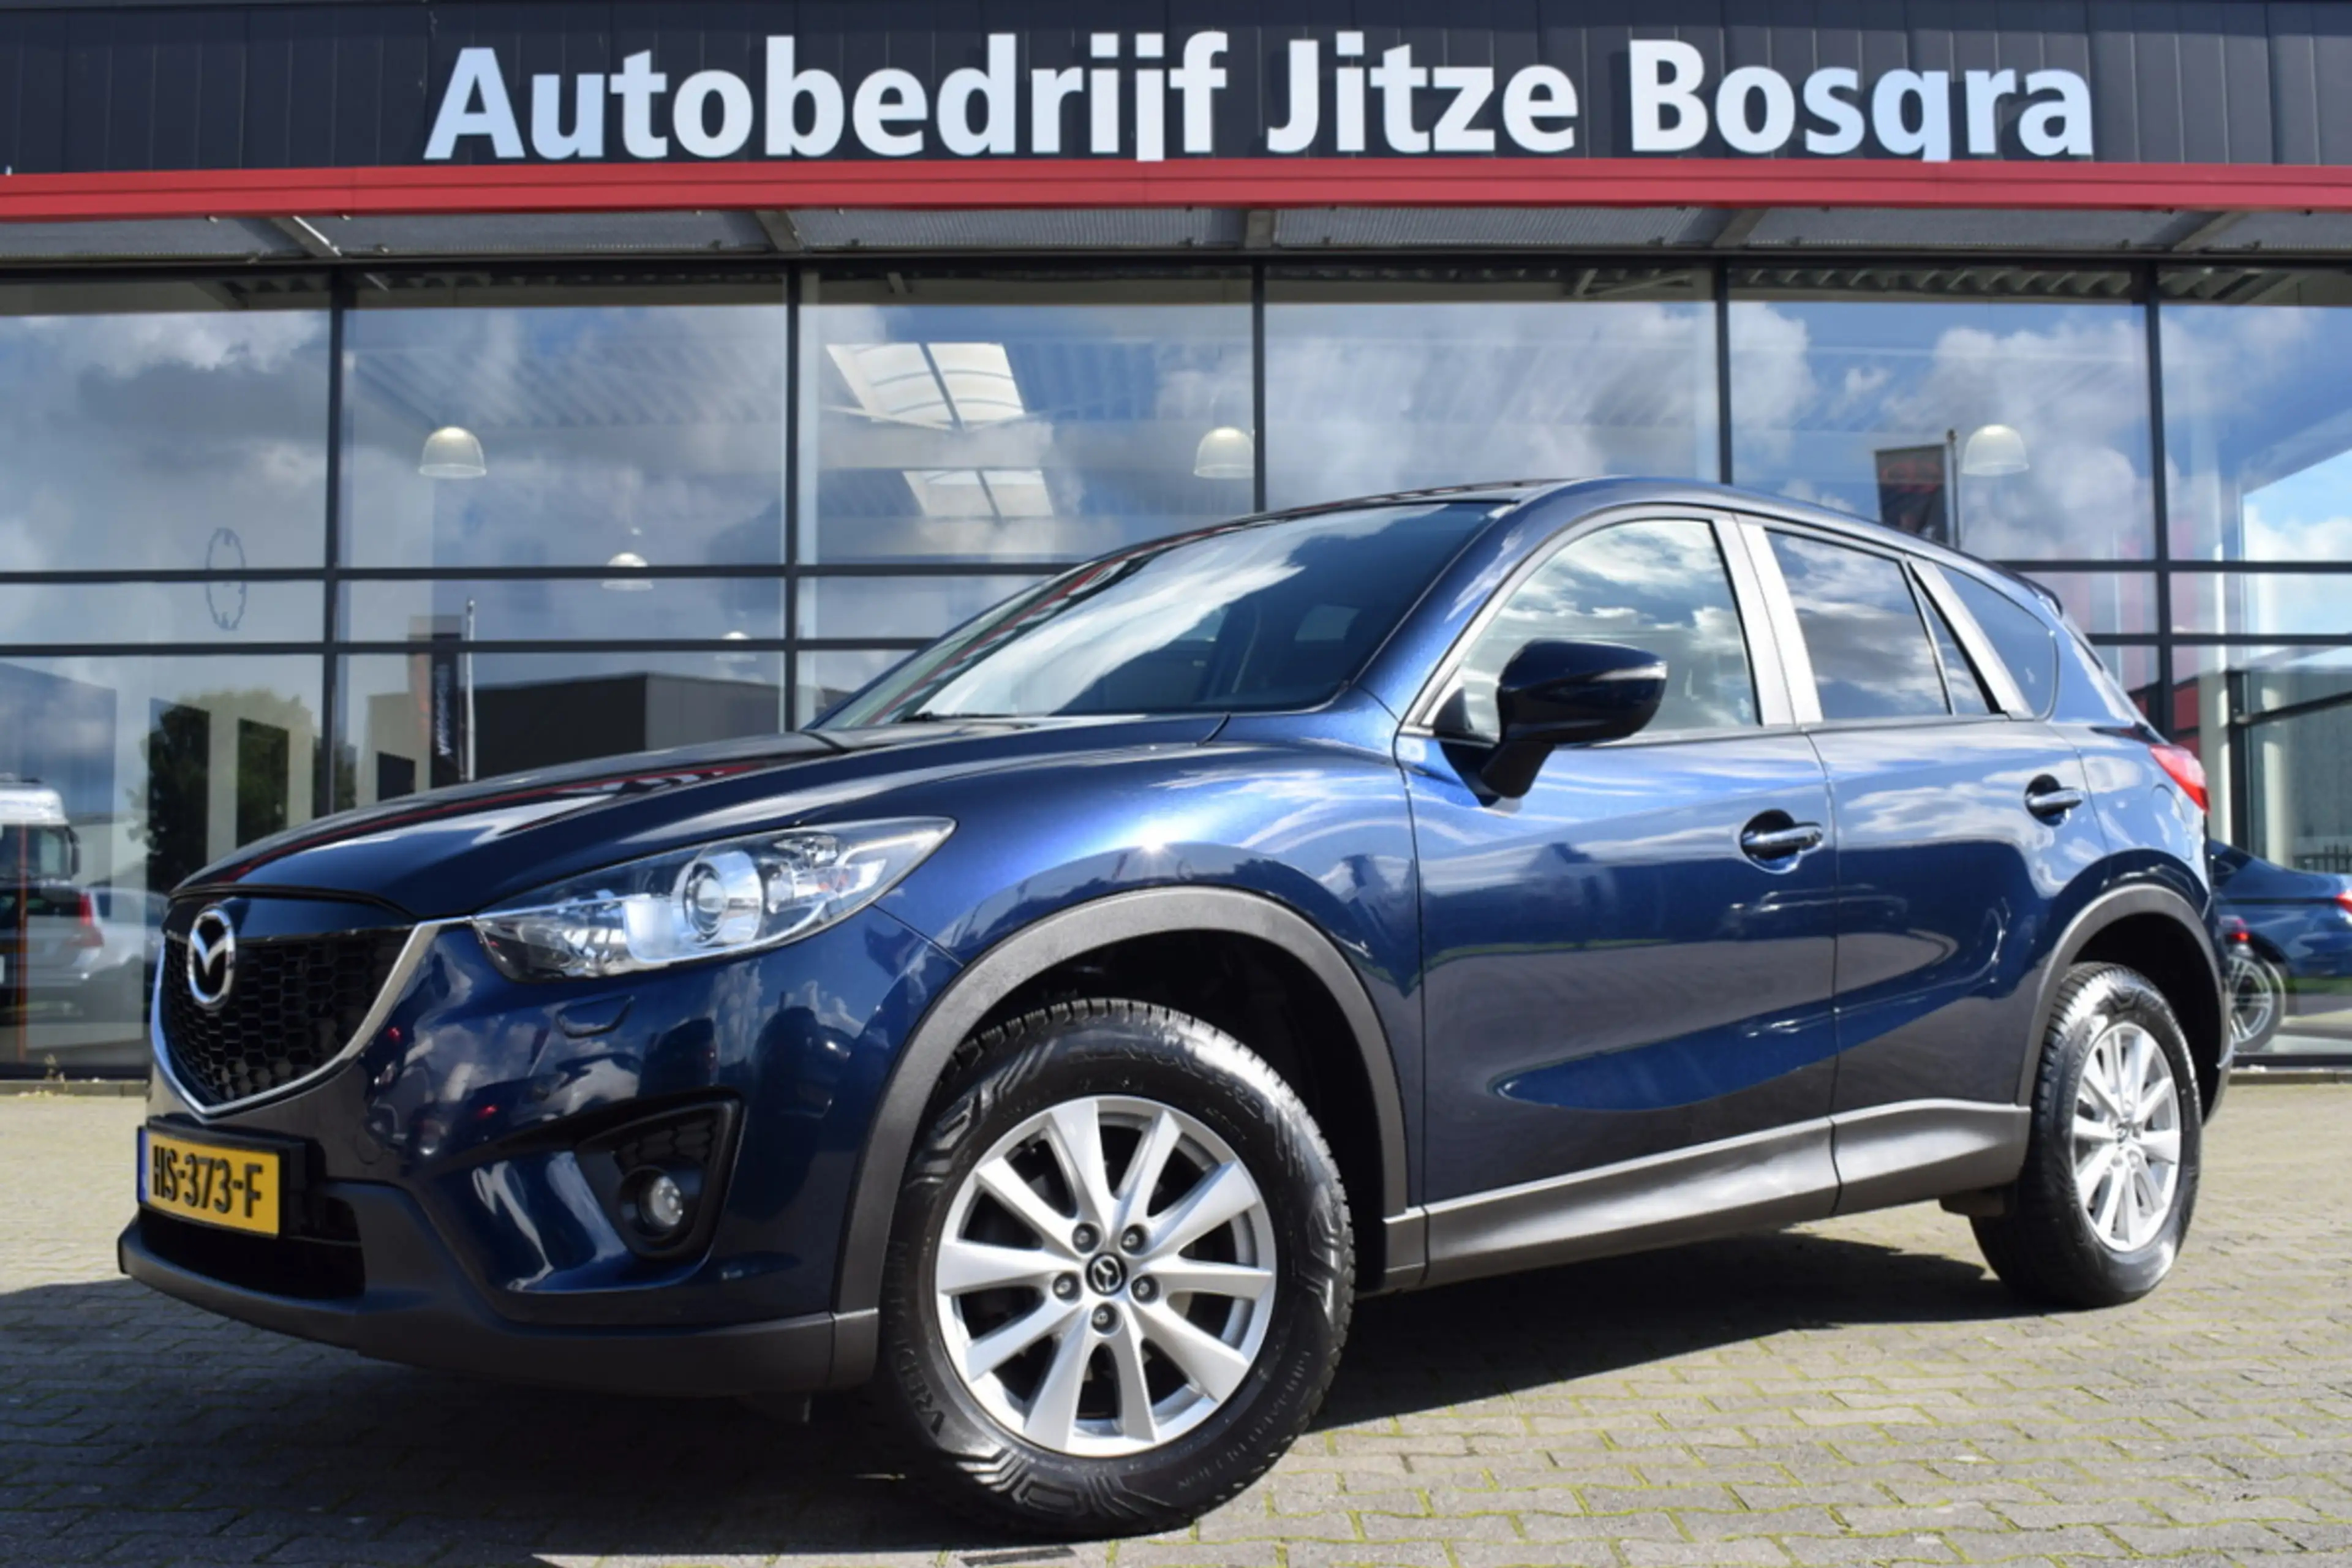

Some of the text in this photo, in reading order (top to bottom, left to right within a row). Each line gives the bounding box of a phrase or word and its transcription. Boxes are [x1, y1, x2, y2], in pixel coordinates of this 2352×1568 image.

[423, 31, 1227, 161] Autobedrijf
[1267, 31, 1578, 153] Jitze
[153, 1144, 263, 1218] HS-373-F
